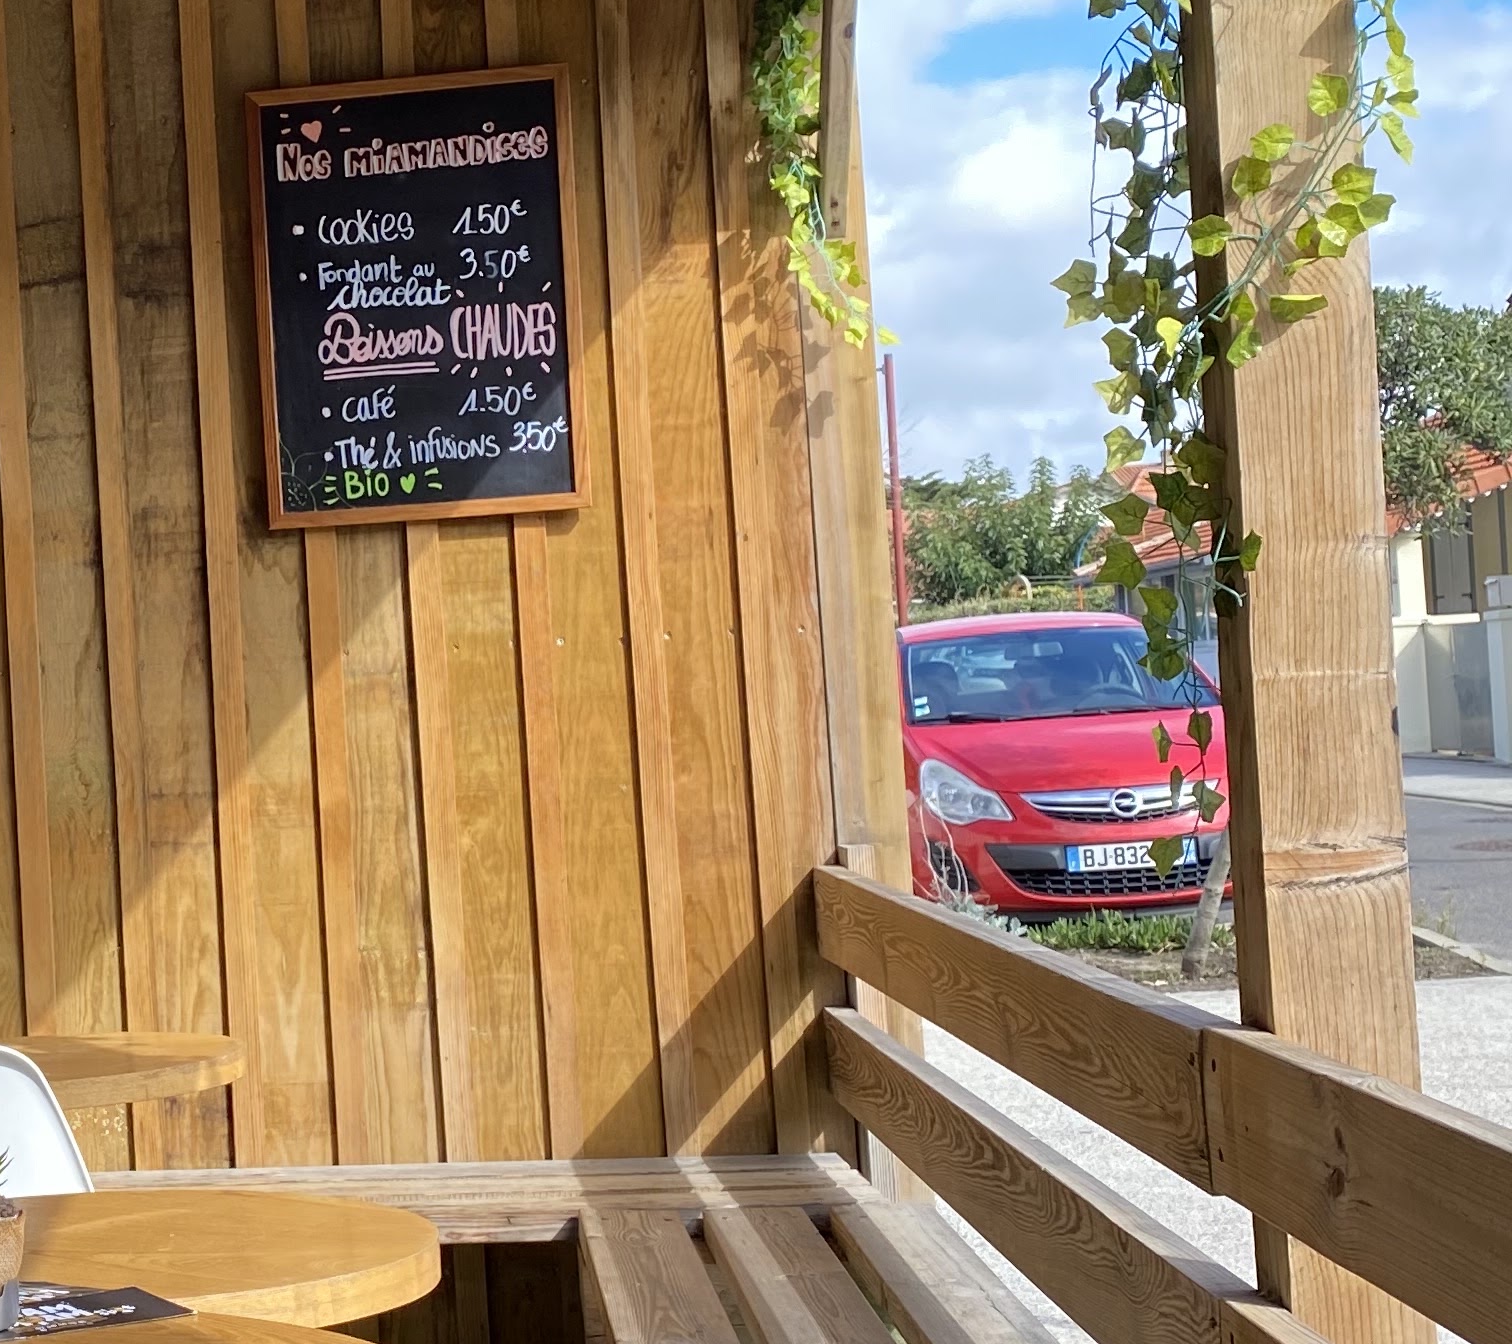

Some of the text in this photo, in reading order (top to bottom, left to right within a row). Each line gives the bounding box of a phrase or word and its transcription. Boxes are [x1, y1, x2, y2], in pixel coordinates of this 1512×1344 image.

[318, 254, 403, 291] Fondant
[412, 262, 435, 278] au
[449, 302, 557, 360] CHAUDES
[334, 436, 379, 469] Thé
[382, 431, 402, 469] &
